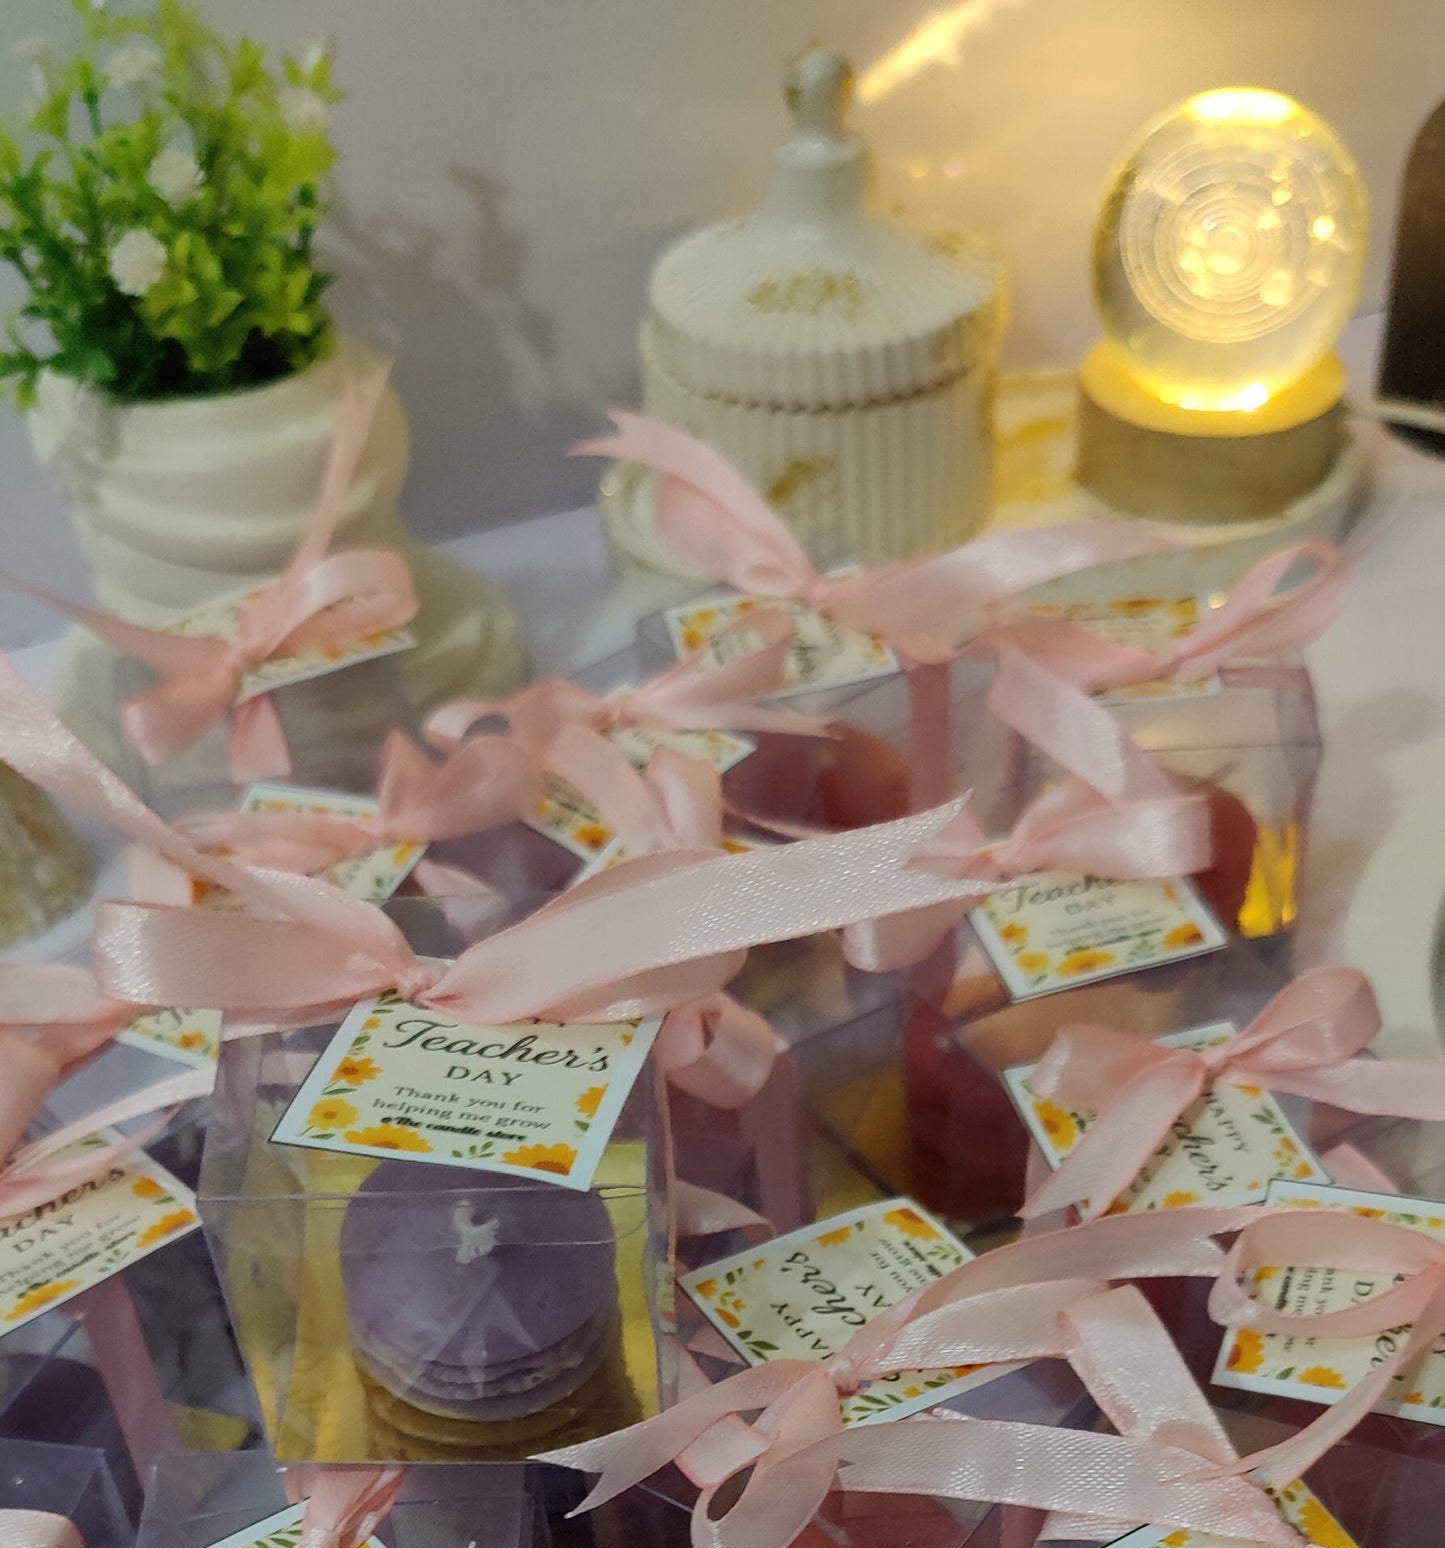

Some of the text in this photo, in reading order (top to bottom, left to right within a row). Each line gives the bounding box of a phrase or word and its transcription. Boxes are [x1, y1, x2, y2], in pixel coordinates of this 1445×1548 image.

[383, 1018, 609, 1072] Teacher's
[445, 1065, 523, 1086] DAY
[372, 1098, 552, 1131] helping me grow
[394, 1085, 546, 1114] Thank you for
[1171, 1116, 1234, 1192] cher's
[13, 1214, 74, 1253] DAY
[779, 1251, 867, 1326] cher's
[854, 1283, 893, 1309] AY
